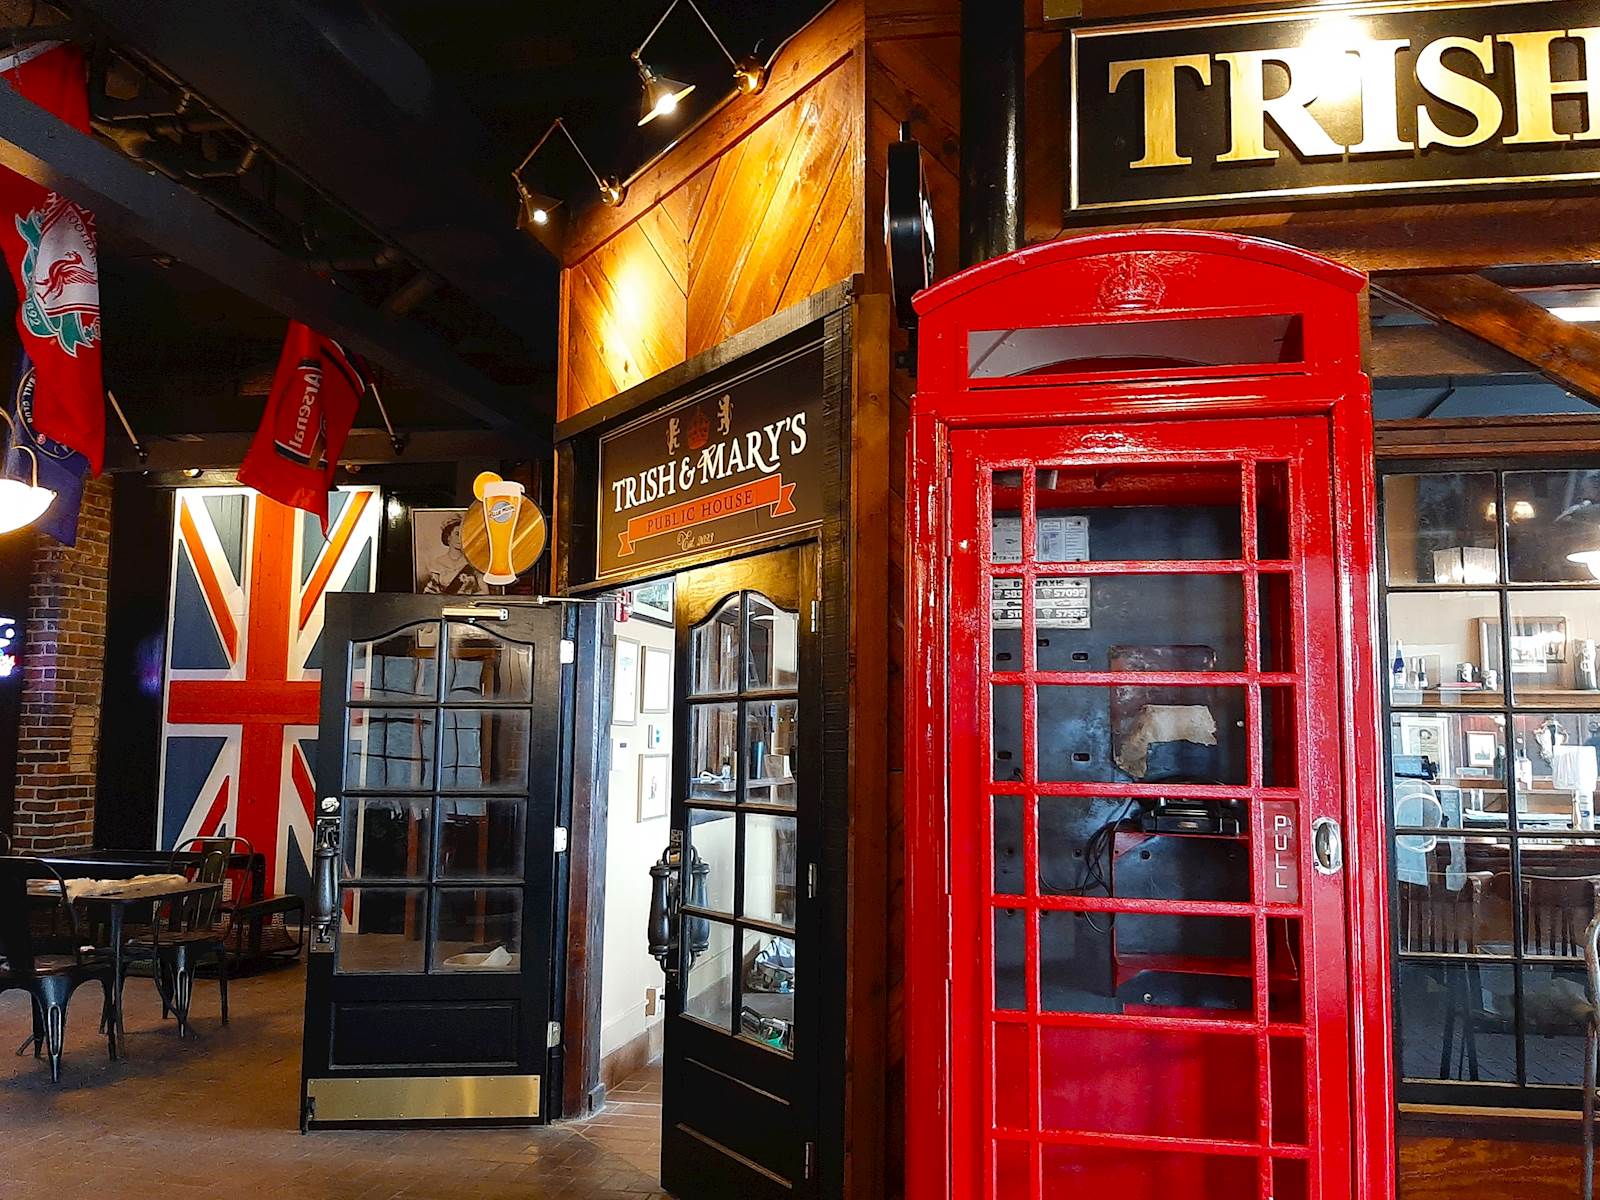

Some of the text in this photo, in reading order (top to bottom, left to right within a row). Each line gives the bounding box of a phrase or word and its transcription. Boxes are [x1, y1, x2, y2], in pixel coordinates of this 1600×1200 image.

[1108, 26, 1600, 170] TRISH
[22, 400, 34, 423] CLUB
[611, 411, 808, 513] TRISH & MARY'S
[647, 489, 754, 533] PUBLIC HOUSE
[1053, 588, 1087, 598] 57099
[1055, 608, 1087, 618] 57556
[1274, 815, 1289, 889] PULL
